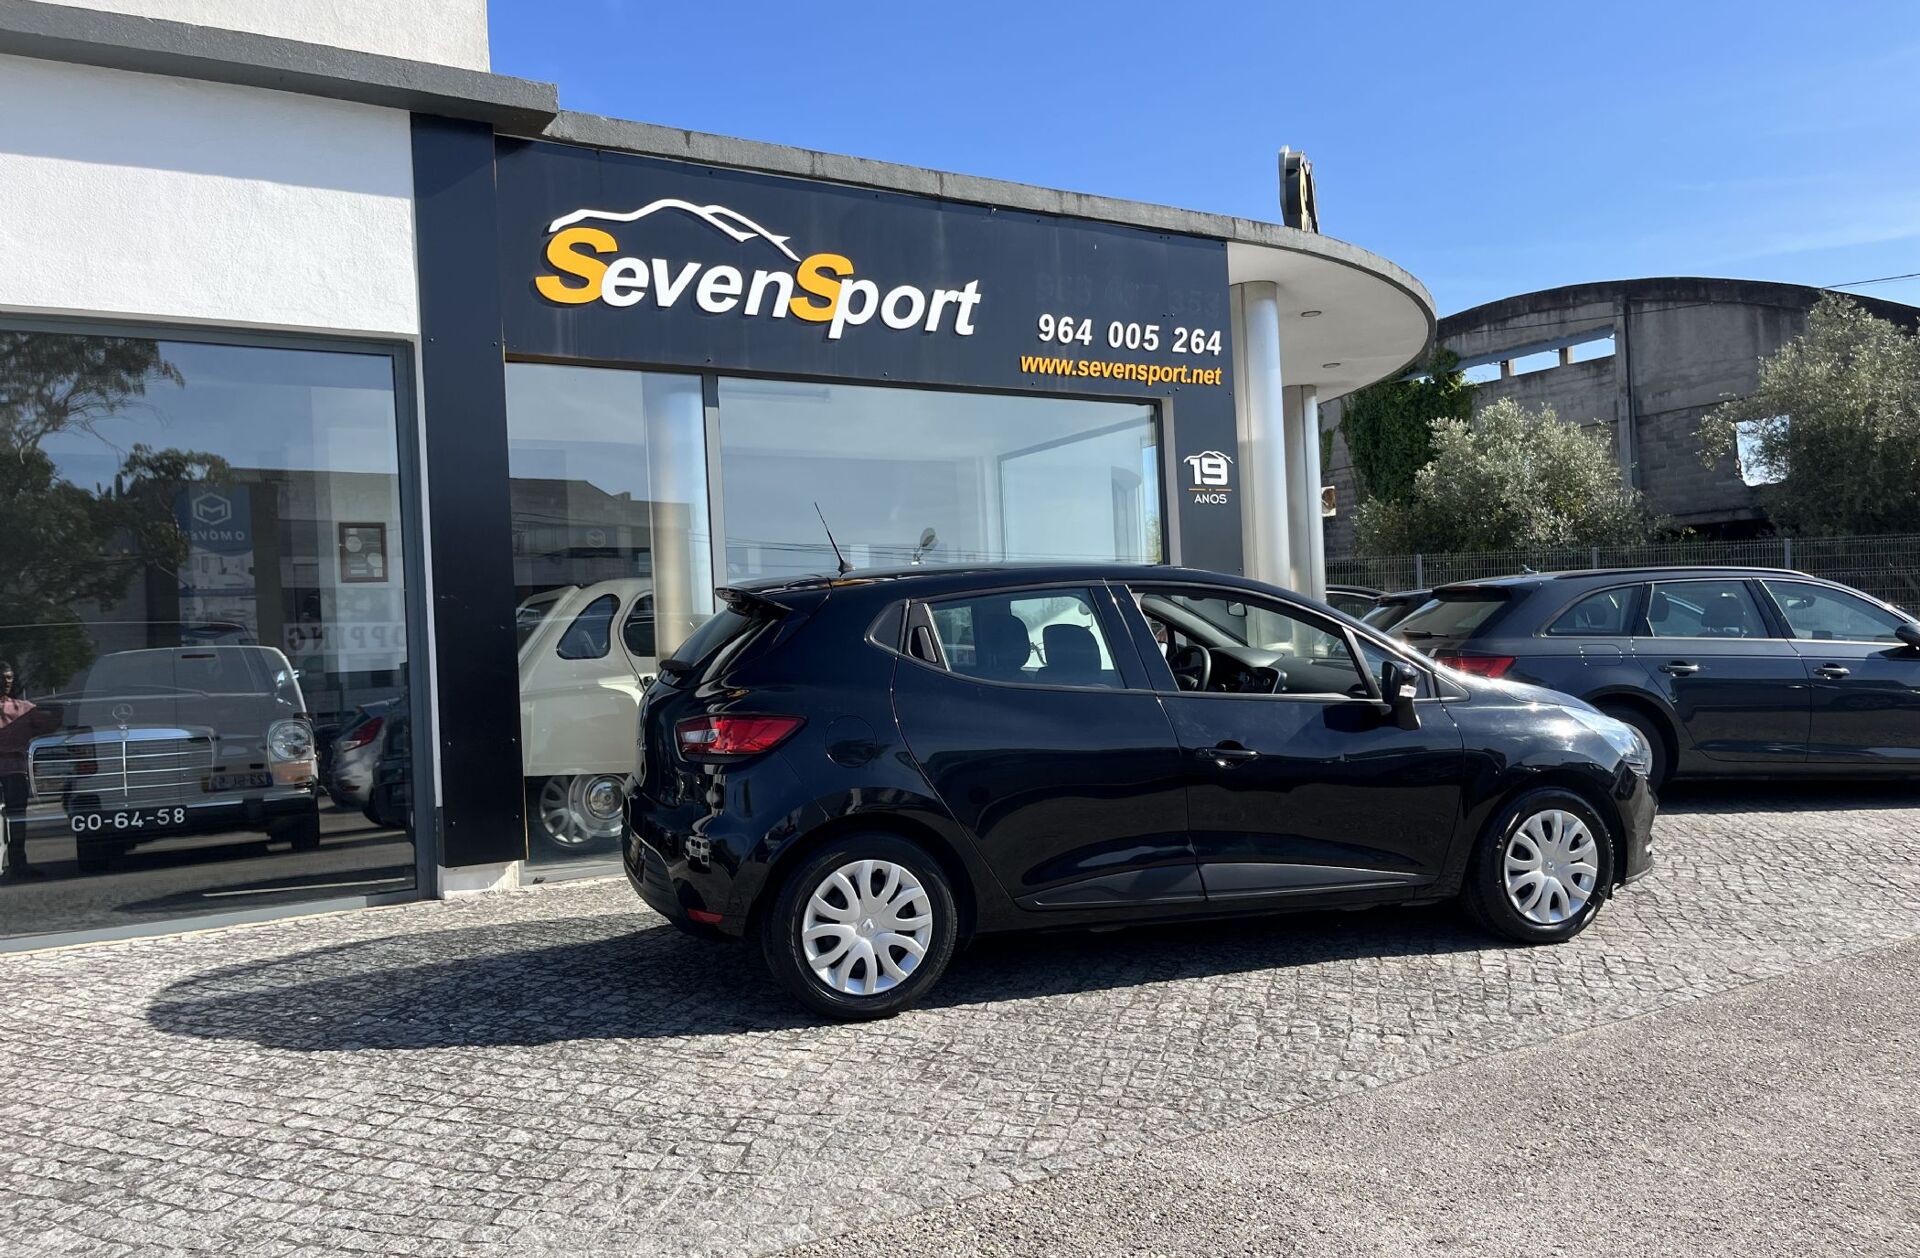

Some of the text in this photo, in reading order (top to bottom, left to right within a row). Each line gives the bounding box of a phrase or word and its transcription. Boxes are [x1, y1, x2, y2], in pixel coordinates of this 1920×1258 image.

[535, 227, 981, 340] SevenSport
[1038, 313, 1222, 356] 964 005 264
[1021, 355, 1222, 385] www.sevensport.net
[1189, 457, 1228, 486] 19
[1194, 493, 1228, 504] ANOS
[71, 807, 185, 832] GO-64-58
